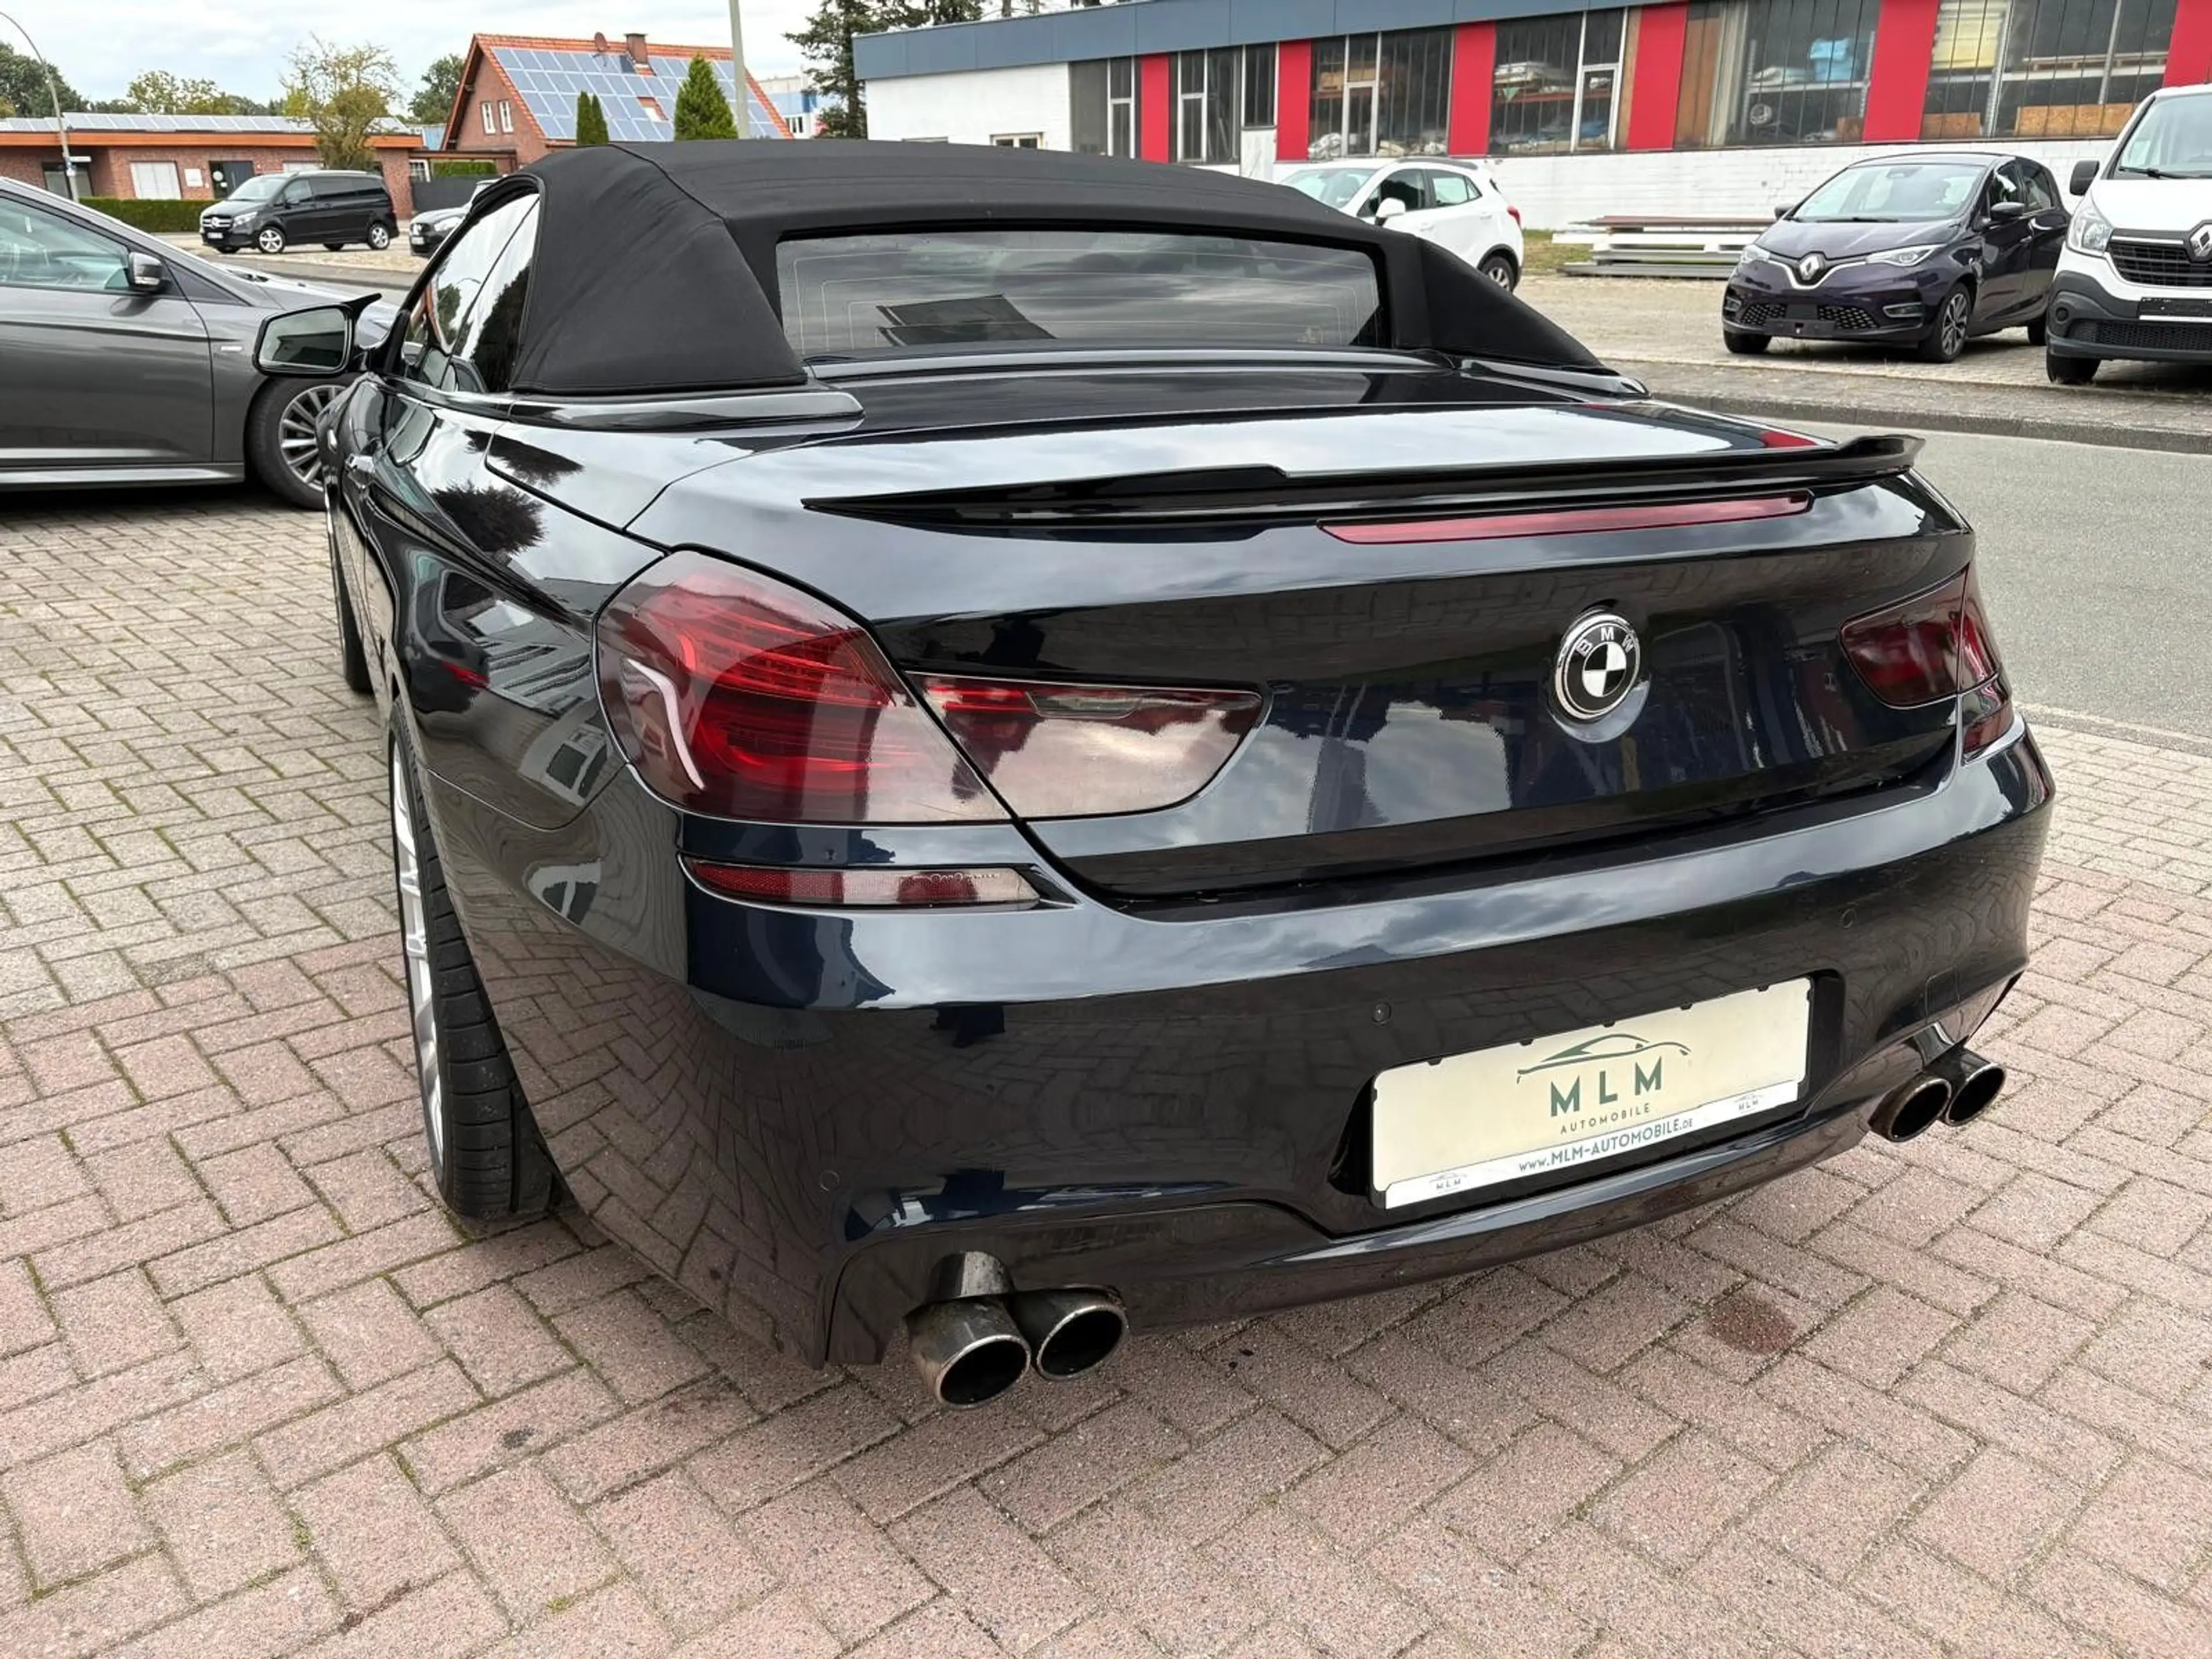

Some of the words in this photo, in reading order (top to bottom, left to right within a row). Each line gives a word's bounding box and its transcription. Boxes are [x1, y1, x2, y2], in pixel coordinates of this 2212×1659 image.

[1575, 626, 1634, 656] BMW
[1550, 1056, 1661, 1118] MLM
[1560, 1102, 1650, 1135] AUTOMOBILE
